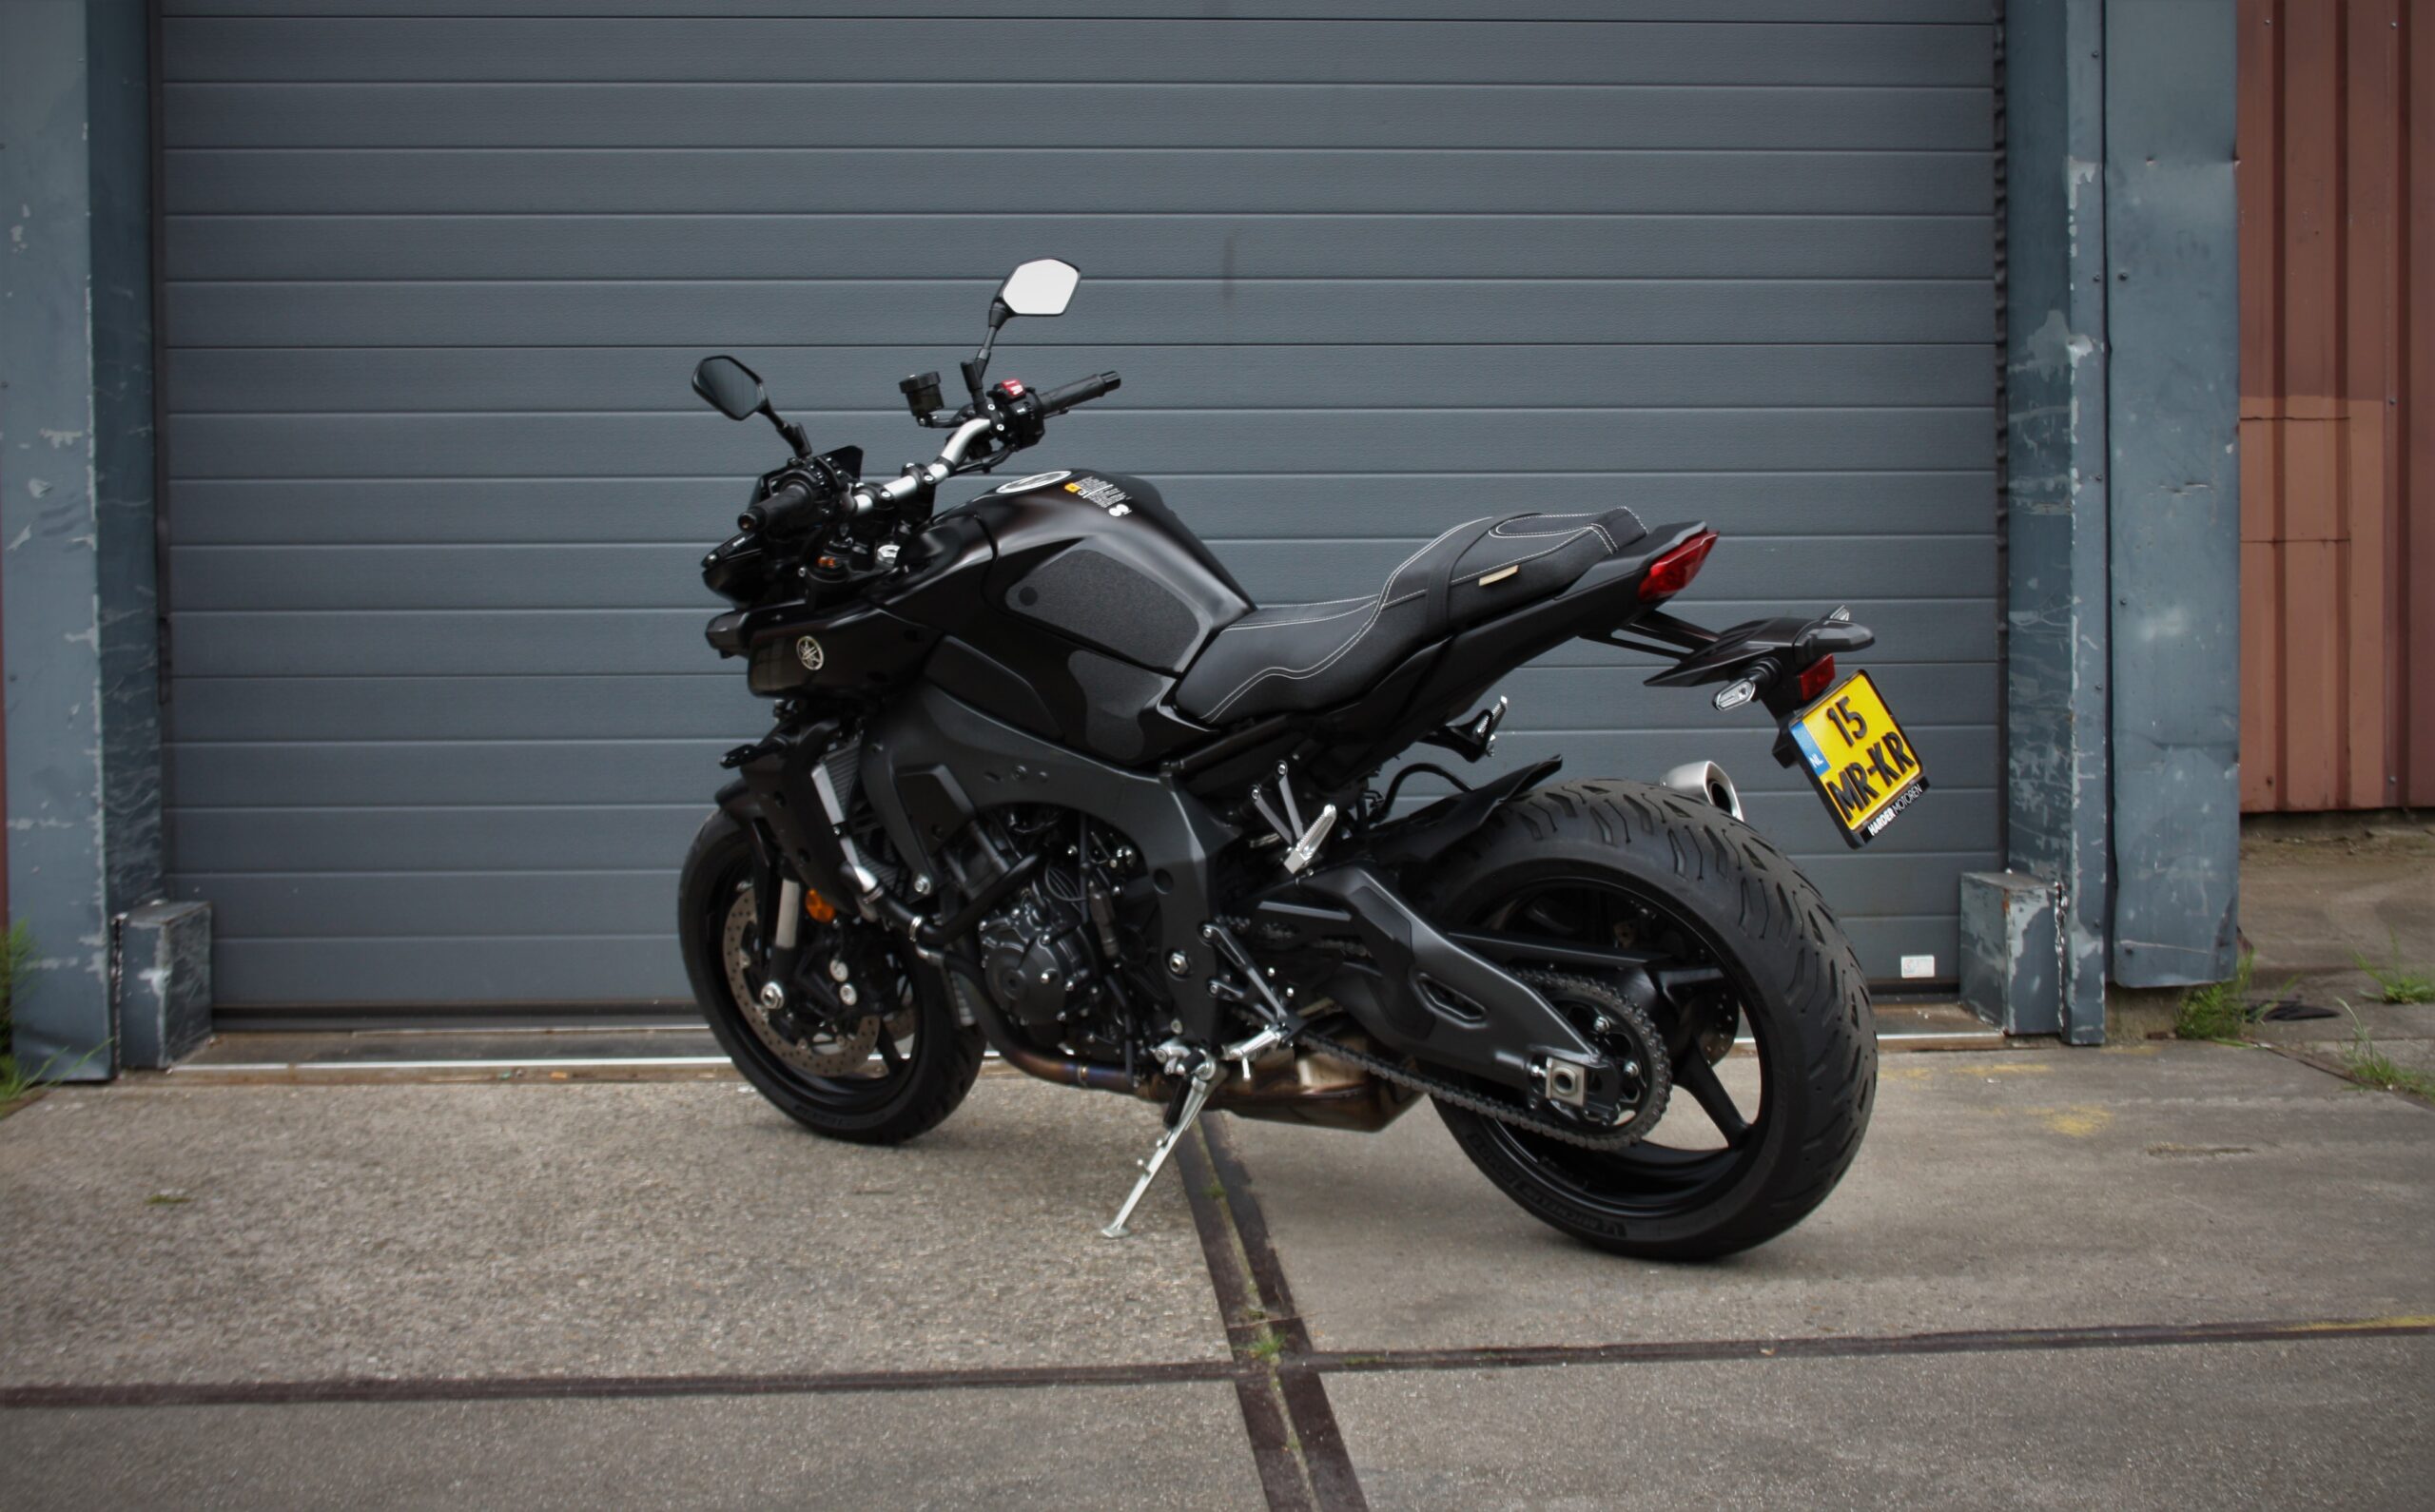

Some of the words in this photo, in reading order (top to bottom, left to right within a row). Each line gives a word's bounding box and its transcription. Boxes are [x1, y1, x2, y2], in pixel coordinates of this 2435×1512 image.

[1826, 696, 1867, 747] 15
[1809, 754, 1823, 769] NL
[1826, 731, 1915, 822] MR-KR
[1867, 807, 1896, 836] HARDER
[1893, 785, 1923, 814] MOTOREN
